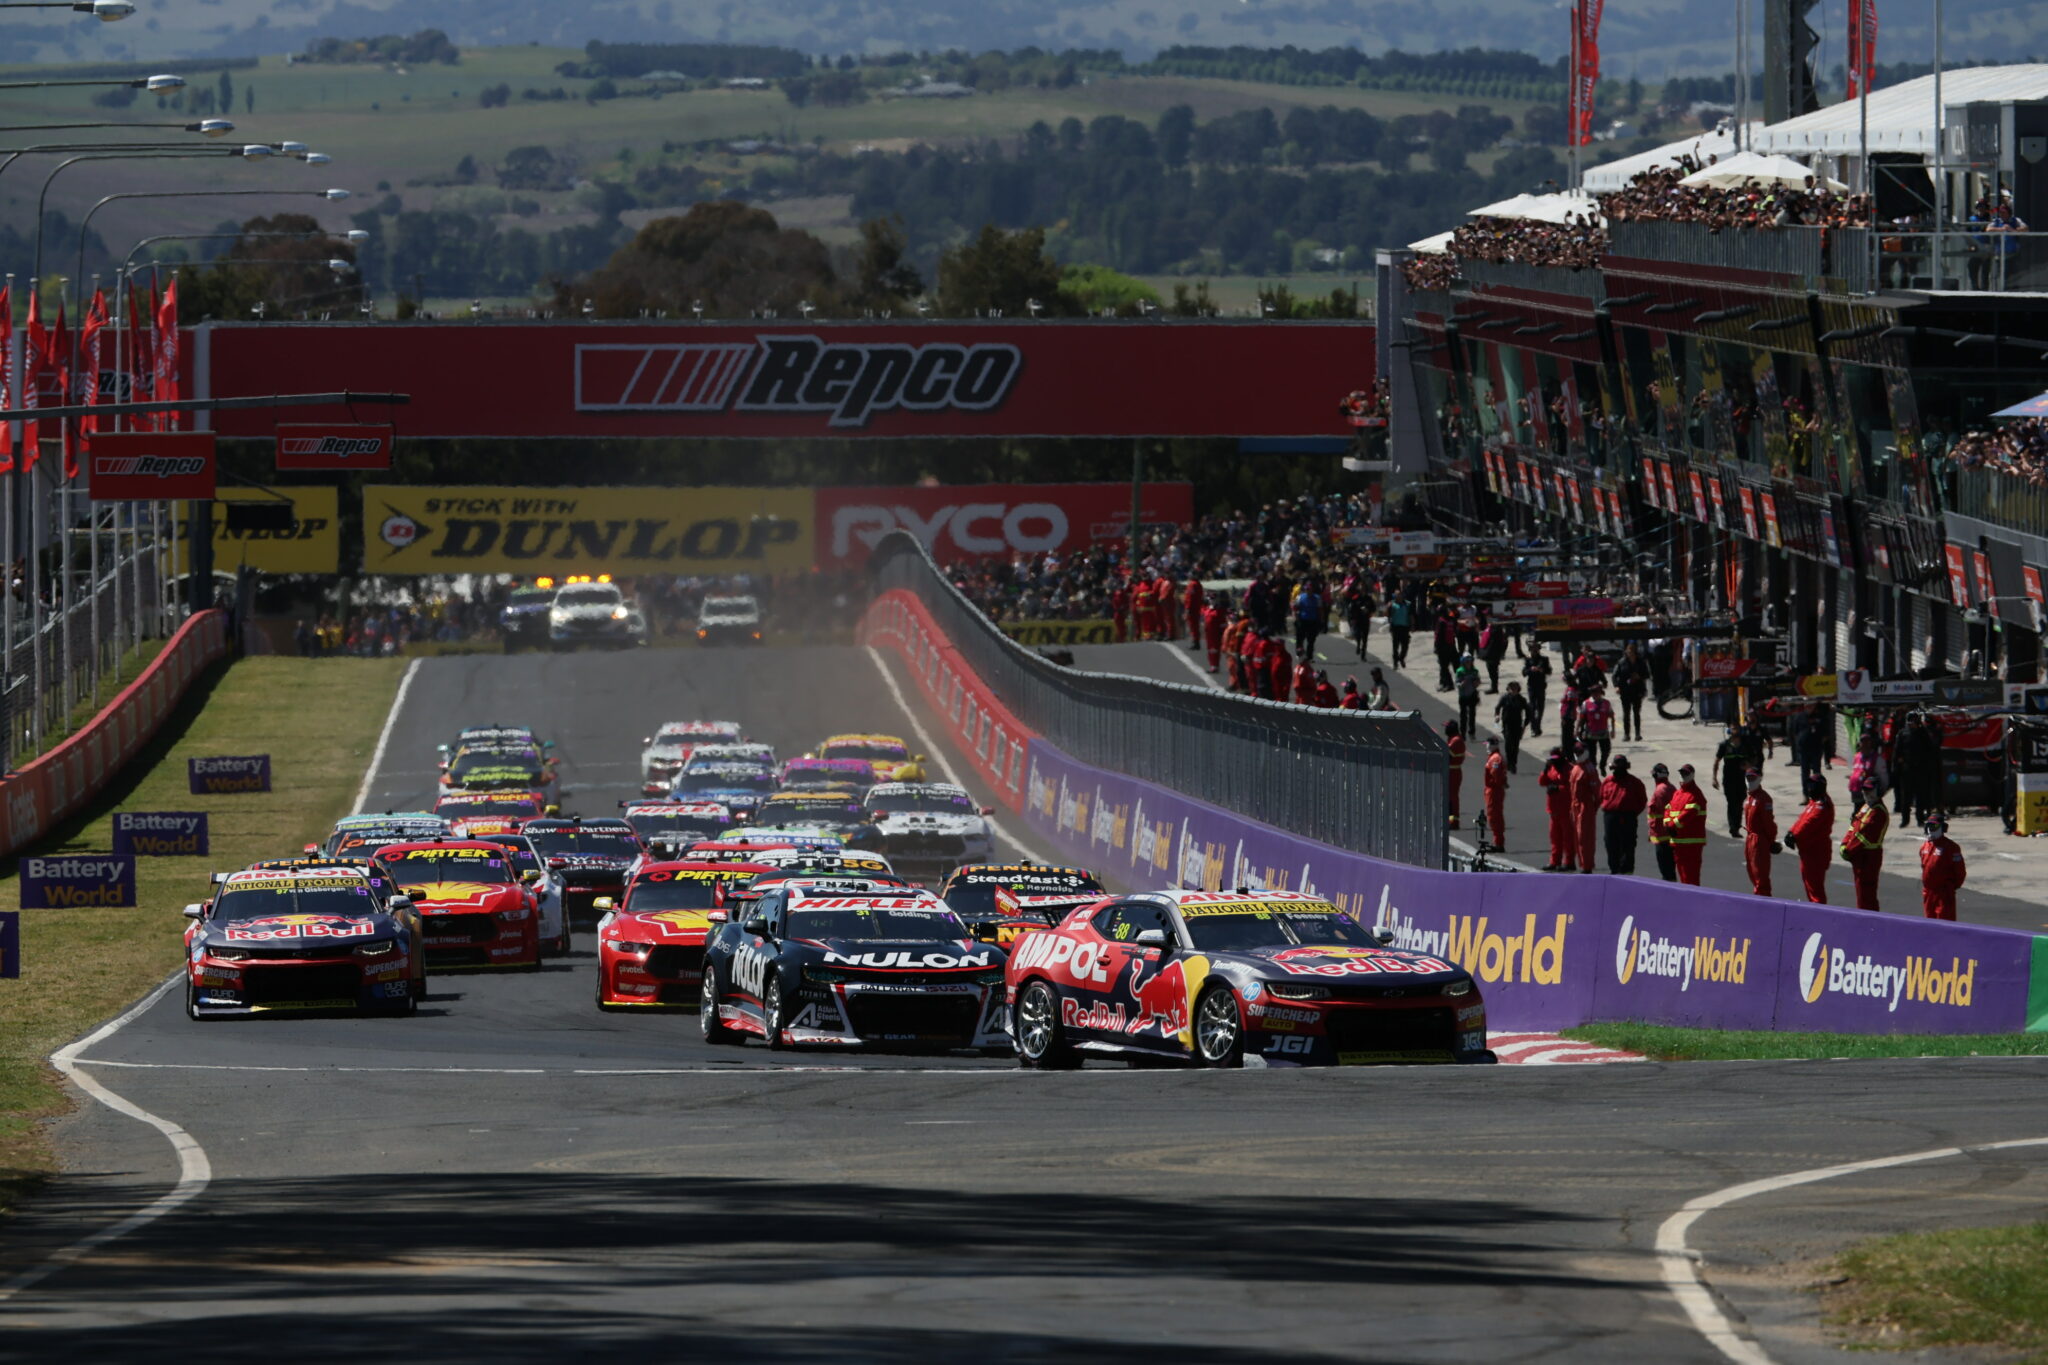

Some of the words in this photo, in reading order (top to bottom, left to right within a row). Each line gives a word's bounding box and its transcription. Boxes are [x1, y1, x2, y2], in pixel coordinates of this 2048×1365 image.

[735, 334, 1021, 426] Repco
[321, 436, 382, 457] Repco
[137, 455, 205, 478] Repco
[424, 498, 501, 515] STICK
[511, 499, 577, 515] WITH
[832, 502, 1069, 557] RYCO
[431, 518, 799, 560] DUNLOP
[194, 758, 264, 774] Battery
[206, 775, 263, 791] World
[631, 805, 722, 815] HIFLEX
[119, 814, 199, 834] Battery
[131, 835, 198, 852] World
[263, 857, 367, 868] PENRITE
[407, 849, 492, 860] PIRTEK
[28, 859, 126, 882] Battery
[675, 870, 762, 881] PIRTE
[969, 865, 1079, 875] PENRITE
[226, 880, 291, 891] NATIONAL
[297, 878, 363, 888] STORAGE
[967, 874, 1061, 884] Steadfast
[44, 885, 125, 905] World
[1026, 884, 1074, 893] Reynolds
[795, 898, 938, 910] HIFLEX
[1183, 902, 1265, 916] NATIONAL
[1268, 902, 1340, 914] STORAGE
[889, 911, 931, 920] Golding
[1287, 913, 1329, 921] Feeney
[225, 924, 300, 941] Red
[303, 921, 375, 937] Bull
[1115, 923, 1132, 940] 88
[1013, 932, 1110, 983] AMPOL
[1449, 914, 1568, 985] World
[823, 951, 990, 968] NULON
[1272, 957, 1373, 978] Red
[1373, 957, 1453, 975] Bull
[1637, 930, 1695, 991] Battery
[1694, 936, 1748, 985] World
[195, 965, 241, 980] SUPERCHEAP
[1829, 948, 1906, 1012] Battery
[1905, 956, 1973, 1007] World
[861, 984, 918, 992] BALLARAT
[925, 985, 969, 993] ISUZU
[1062, 996, 1099, 1030] Red
[1099, 1000, 1127, 1032] Bull
[1247, 1003, 1321, 1025] SUPERCHEAP
[1265, 1019, 1293, 1029] AUTO
[1263, 1034, 1315, 1054] JGI
